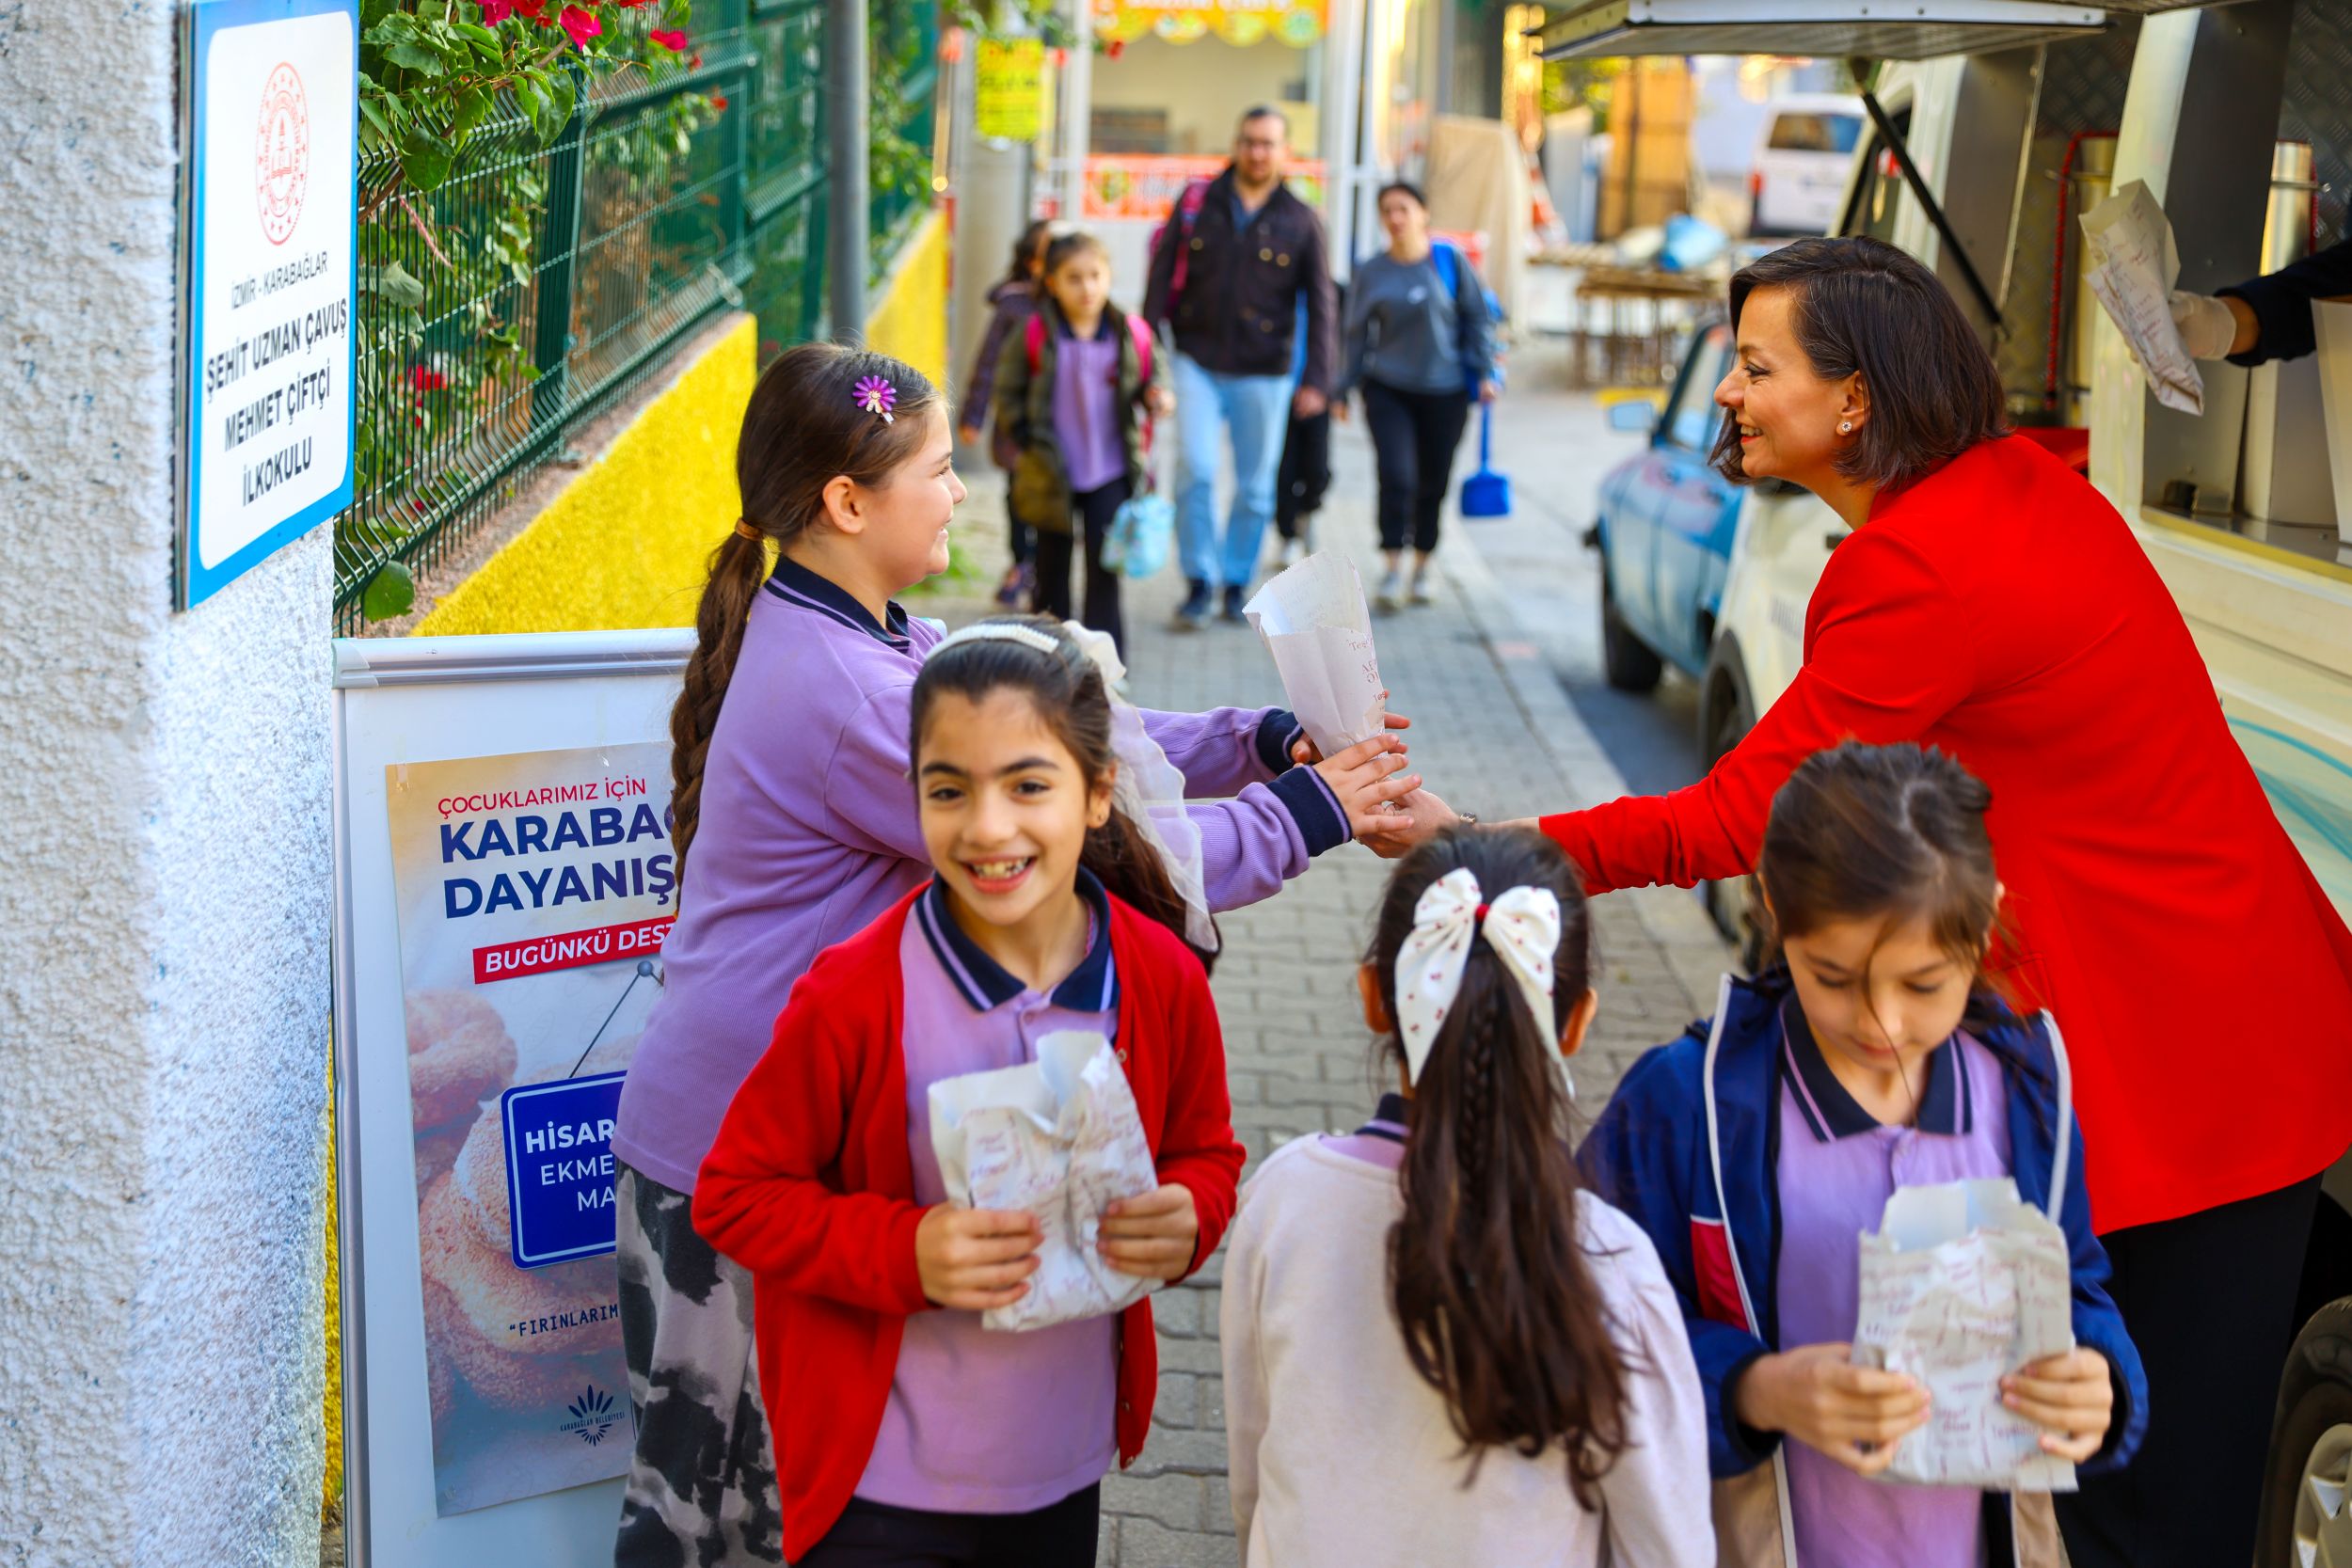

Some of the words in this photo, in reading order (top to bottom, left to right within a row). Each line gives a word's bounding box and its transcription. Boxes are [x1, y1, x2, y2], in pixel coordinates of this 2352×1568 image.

[231, 275, 256, 309] İZMİR
[263, 250, 327, 295] KARABAĞLAR
[207, 336, 248, 404] ŞEHİT
[252, 317, 301, 371] UZMAN
[305, 297, 347, 355] ÇAVUŞ
[225, 388, 283, 452] MEHMET
[287, 357, 330, 425] ÇİFTÇİ
[243, 436, 312, 507] İLKOKULU
[437, 783, 598, 819] ÇOCUKLARIMIZ
[605, 775, 647, 801] İÇİN
[444, 854, 675, 919] DAYANIŞ
[485, 929, 611, 974] BUGÜNKÜ
[525, 1118, 615, 1154] HİSAR
[541, 1154, 615, 1186] EKME
[578, 1186, 616, 1212] MA
